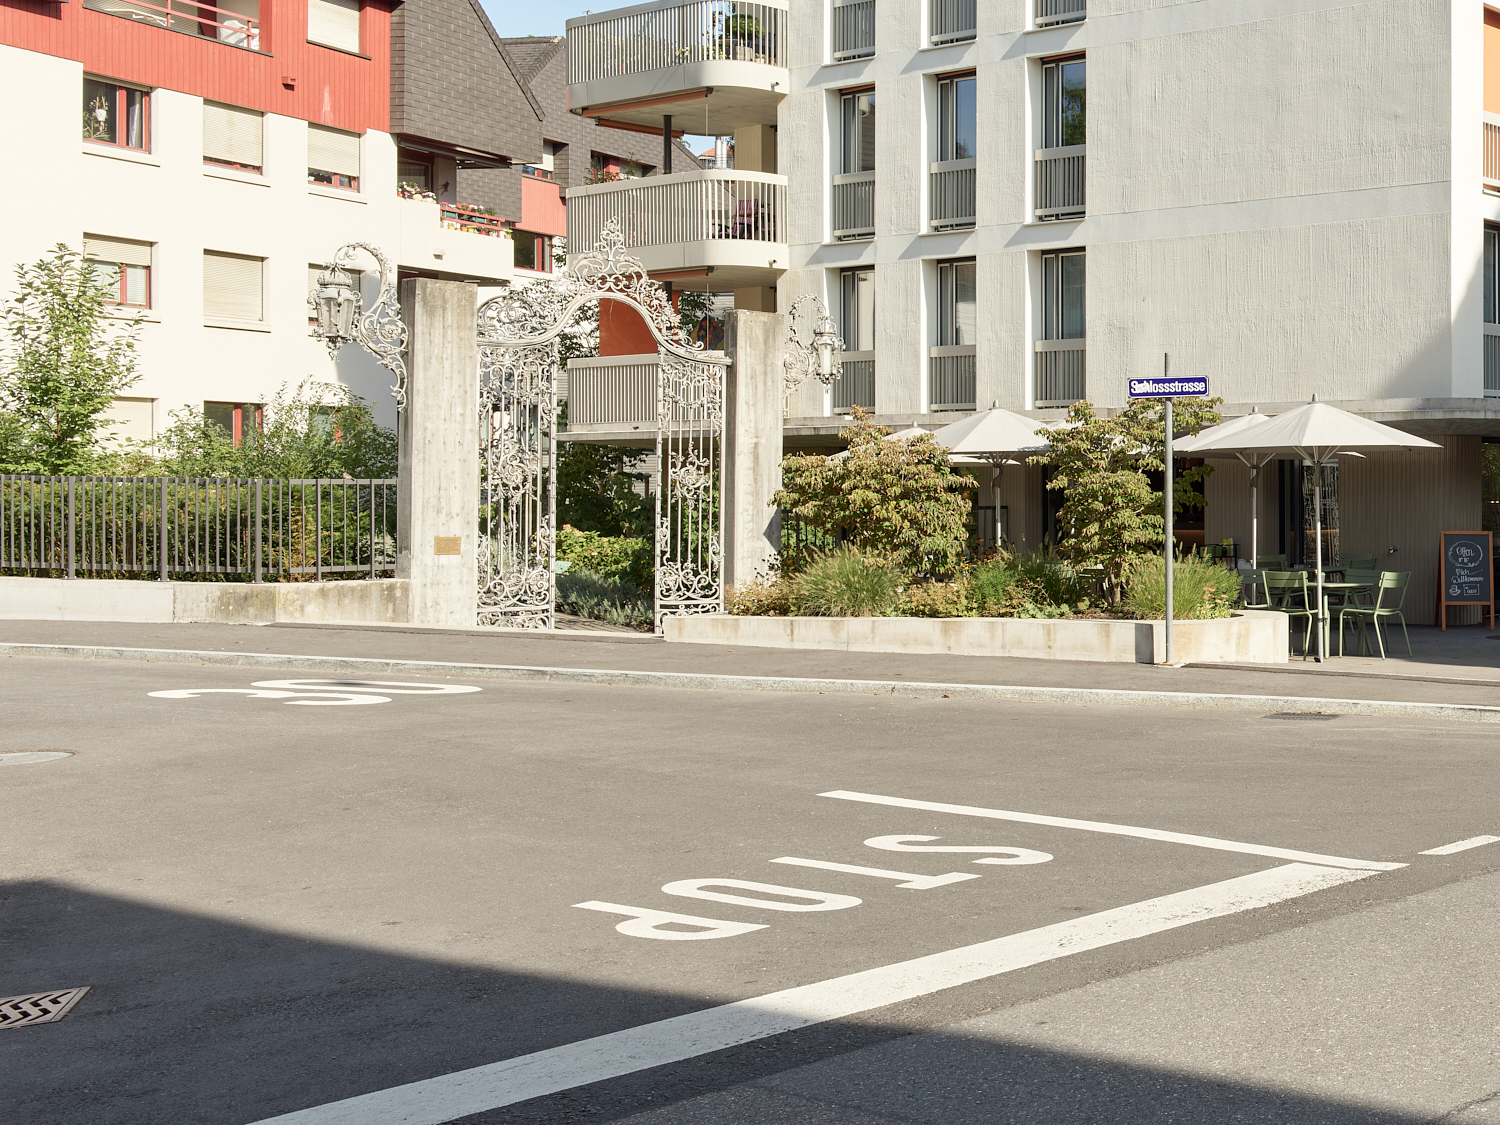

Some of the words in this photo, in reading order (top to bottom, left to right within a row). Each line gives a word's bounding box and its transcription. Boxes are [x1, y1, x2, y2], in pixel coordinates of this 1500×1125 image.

[1131, 380, 1206, 393] Shlossstrasse
[147, 679, 483, 706] 30
[570, 834, 1054, 941] STOP
